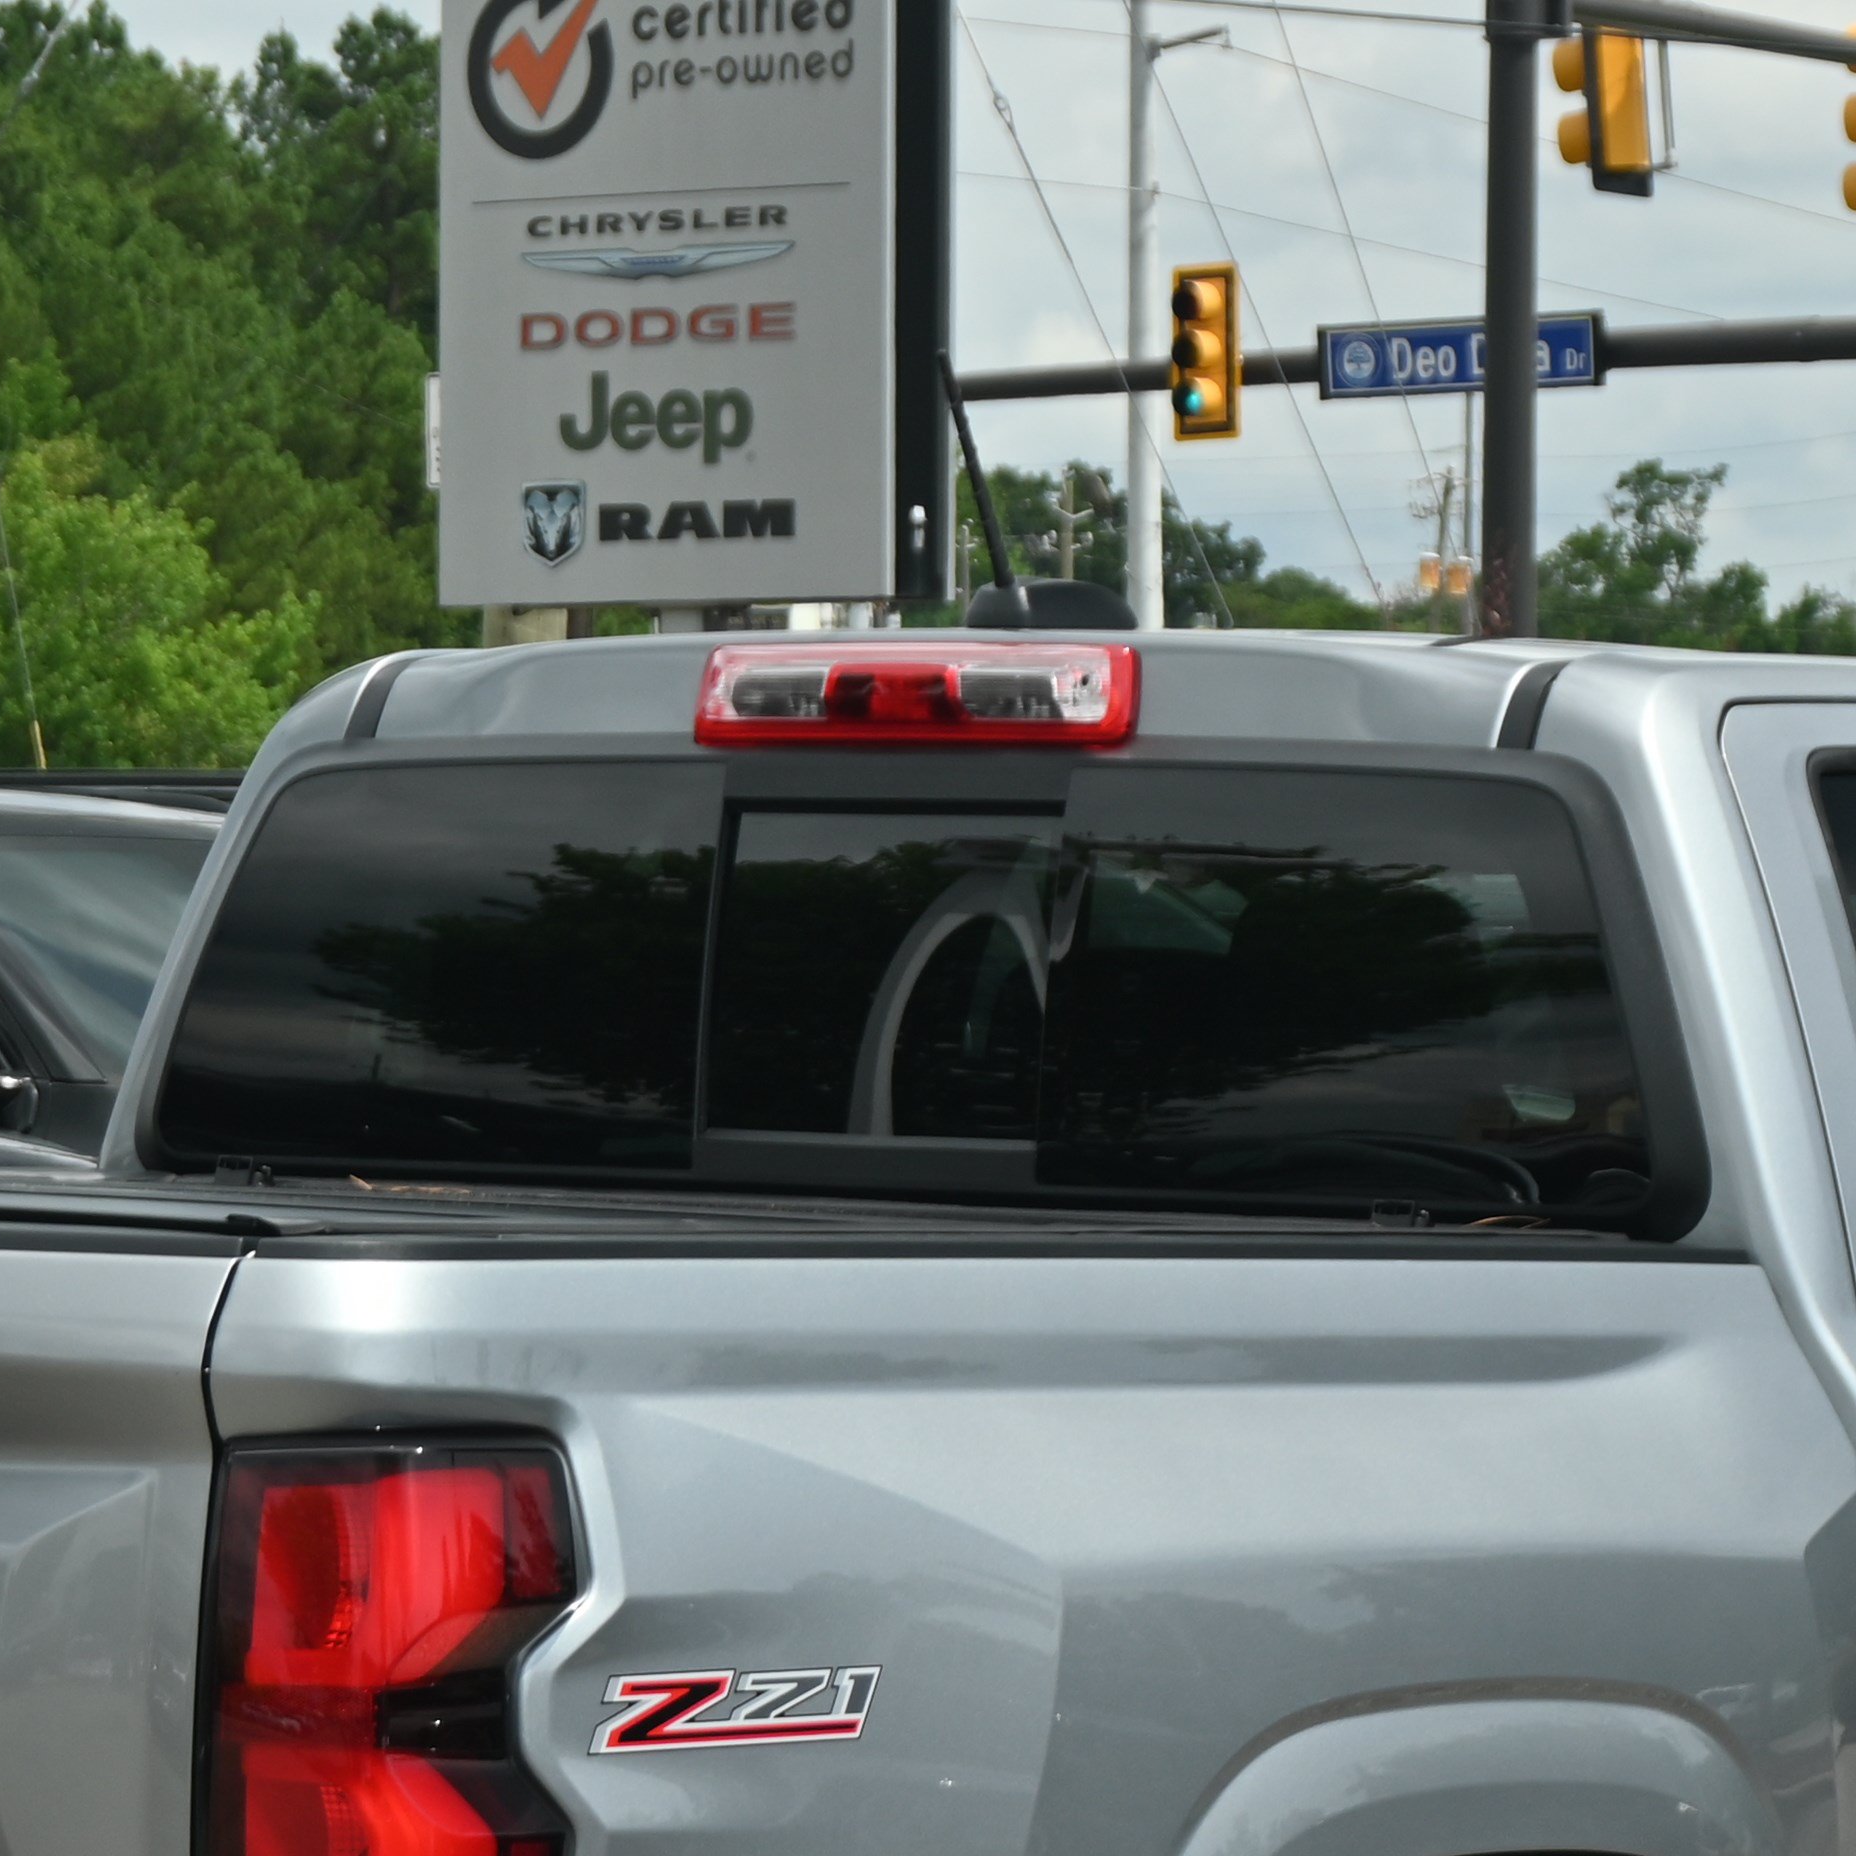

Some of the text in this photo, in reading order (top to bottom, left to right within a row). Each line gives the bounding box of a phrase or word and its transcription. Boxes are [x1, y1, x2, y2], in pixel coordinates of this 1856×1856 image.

[631, 38, 854, 99] pre-owned
[527, 204, 788, 238] CHRYSLER
[519, 302, 797, 351] DODGE
[1392, 336, 1456, 380] Deo
[1565, 347, 1586, 370] Dr
[559, 370, 754, 464] Jeep
[598, 498, 796, 541] RAM
